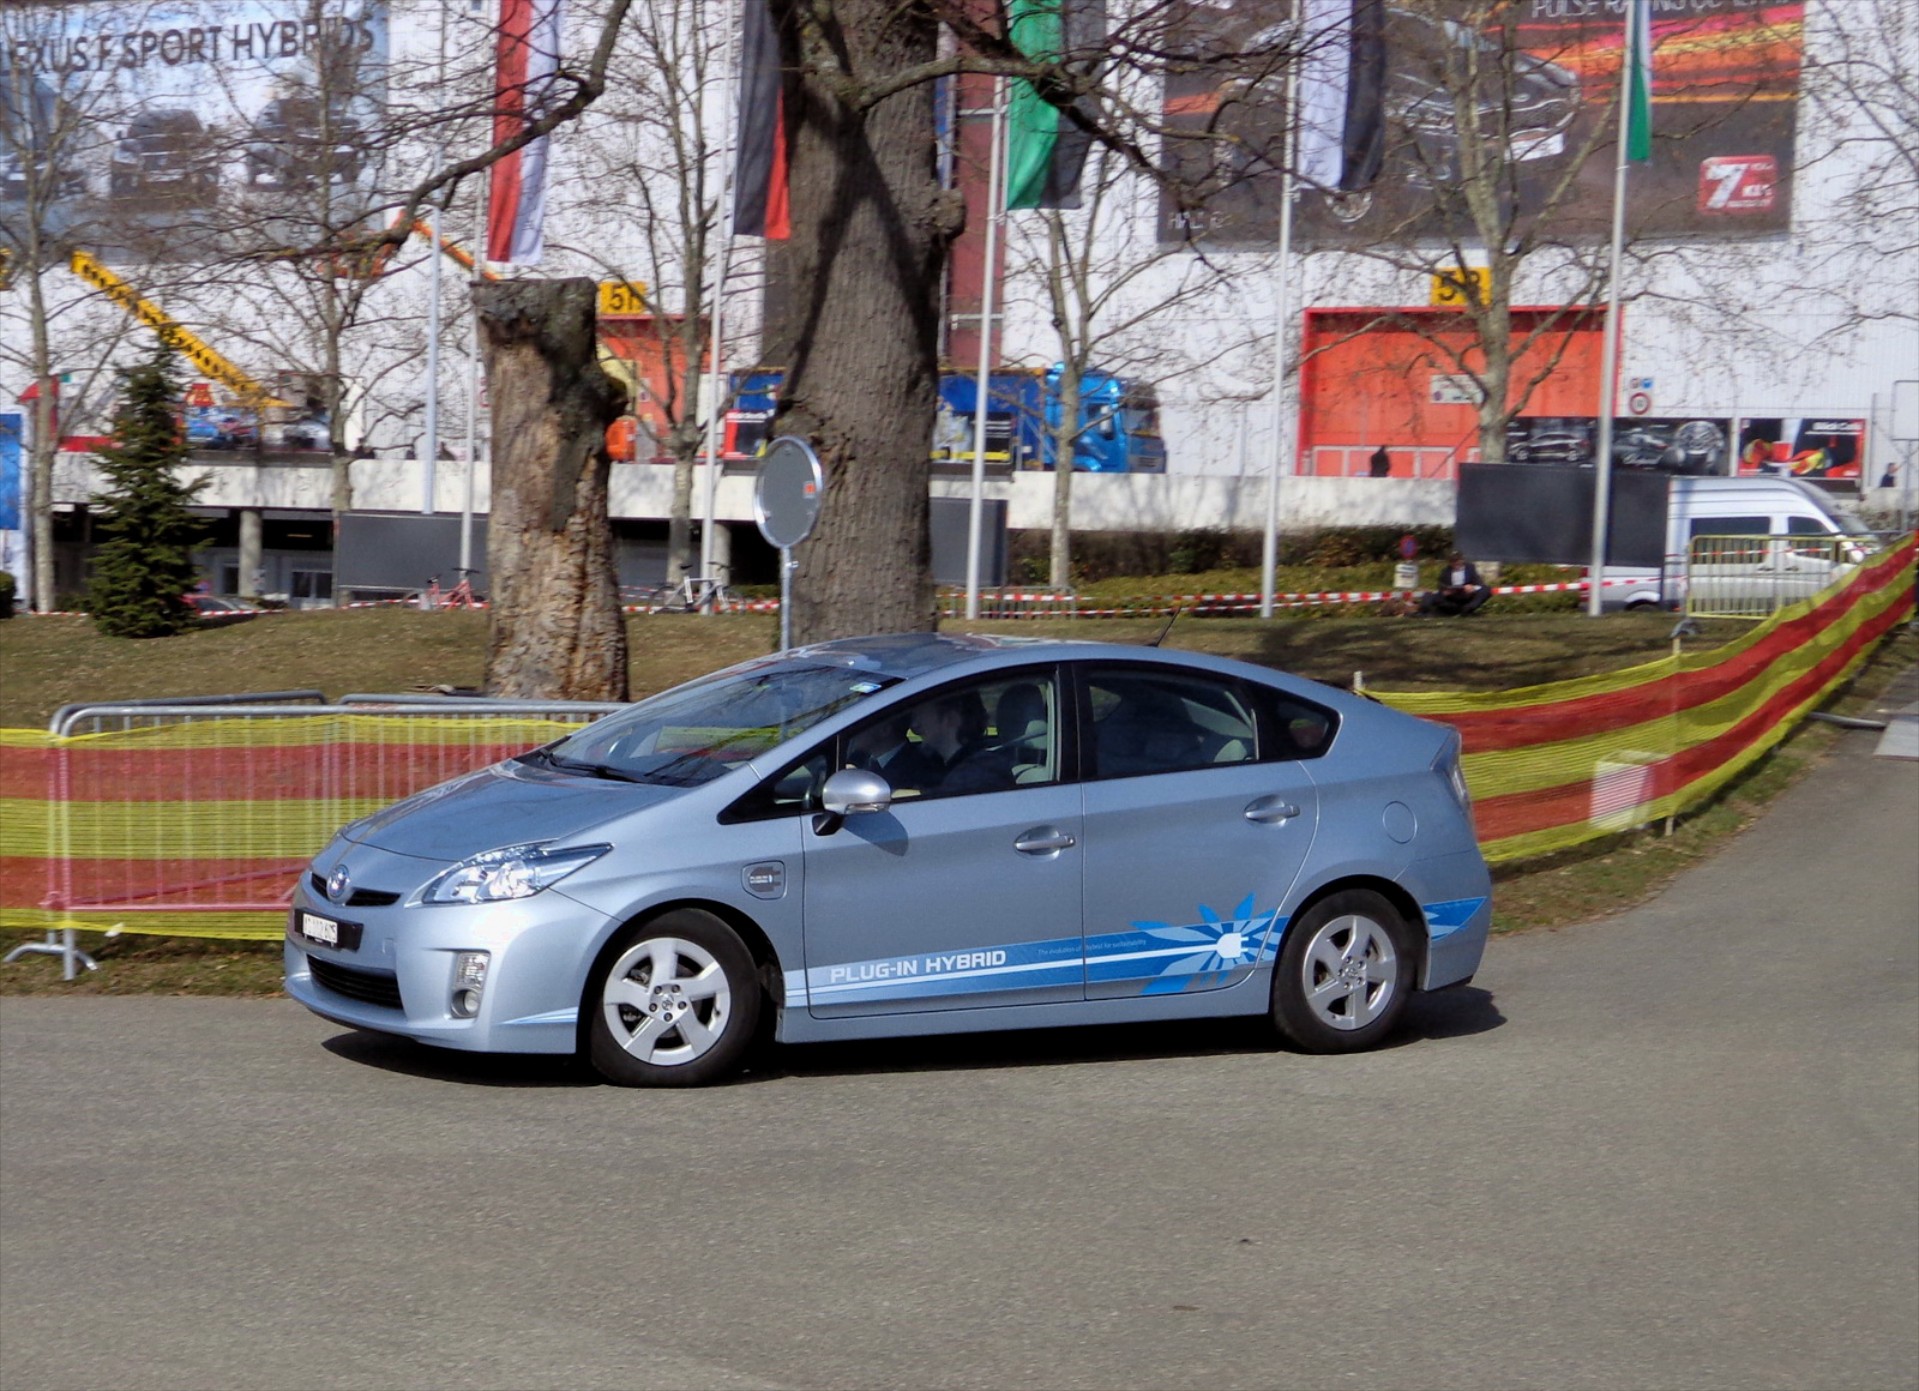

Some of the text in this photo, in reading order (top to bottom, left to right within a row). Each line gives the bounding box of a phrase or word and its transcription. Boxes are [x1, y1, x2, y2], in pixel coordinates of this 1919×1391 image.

[119, 26, 222, 68] SPORT
[1705, 163, 1749, 209] 7
[830, 950, 1006, 983] PLUG-IN HYBRID
